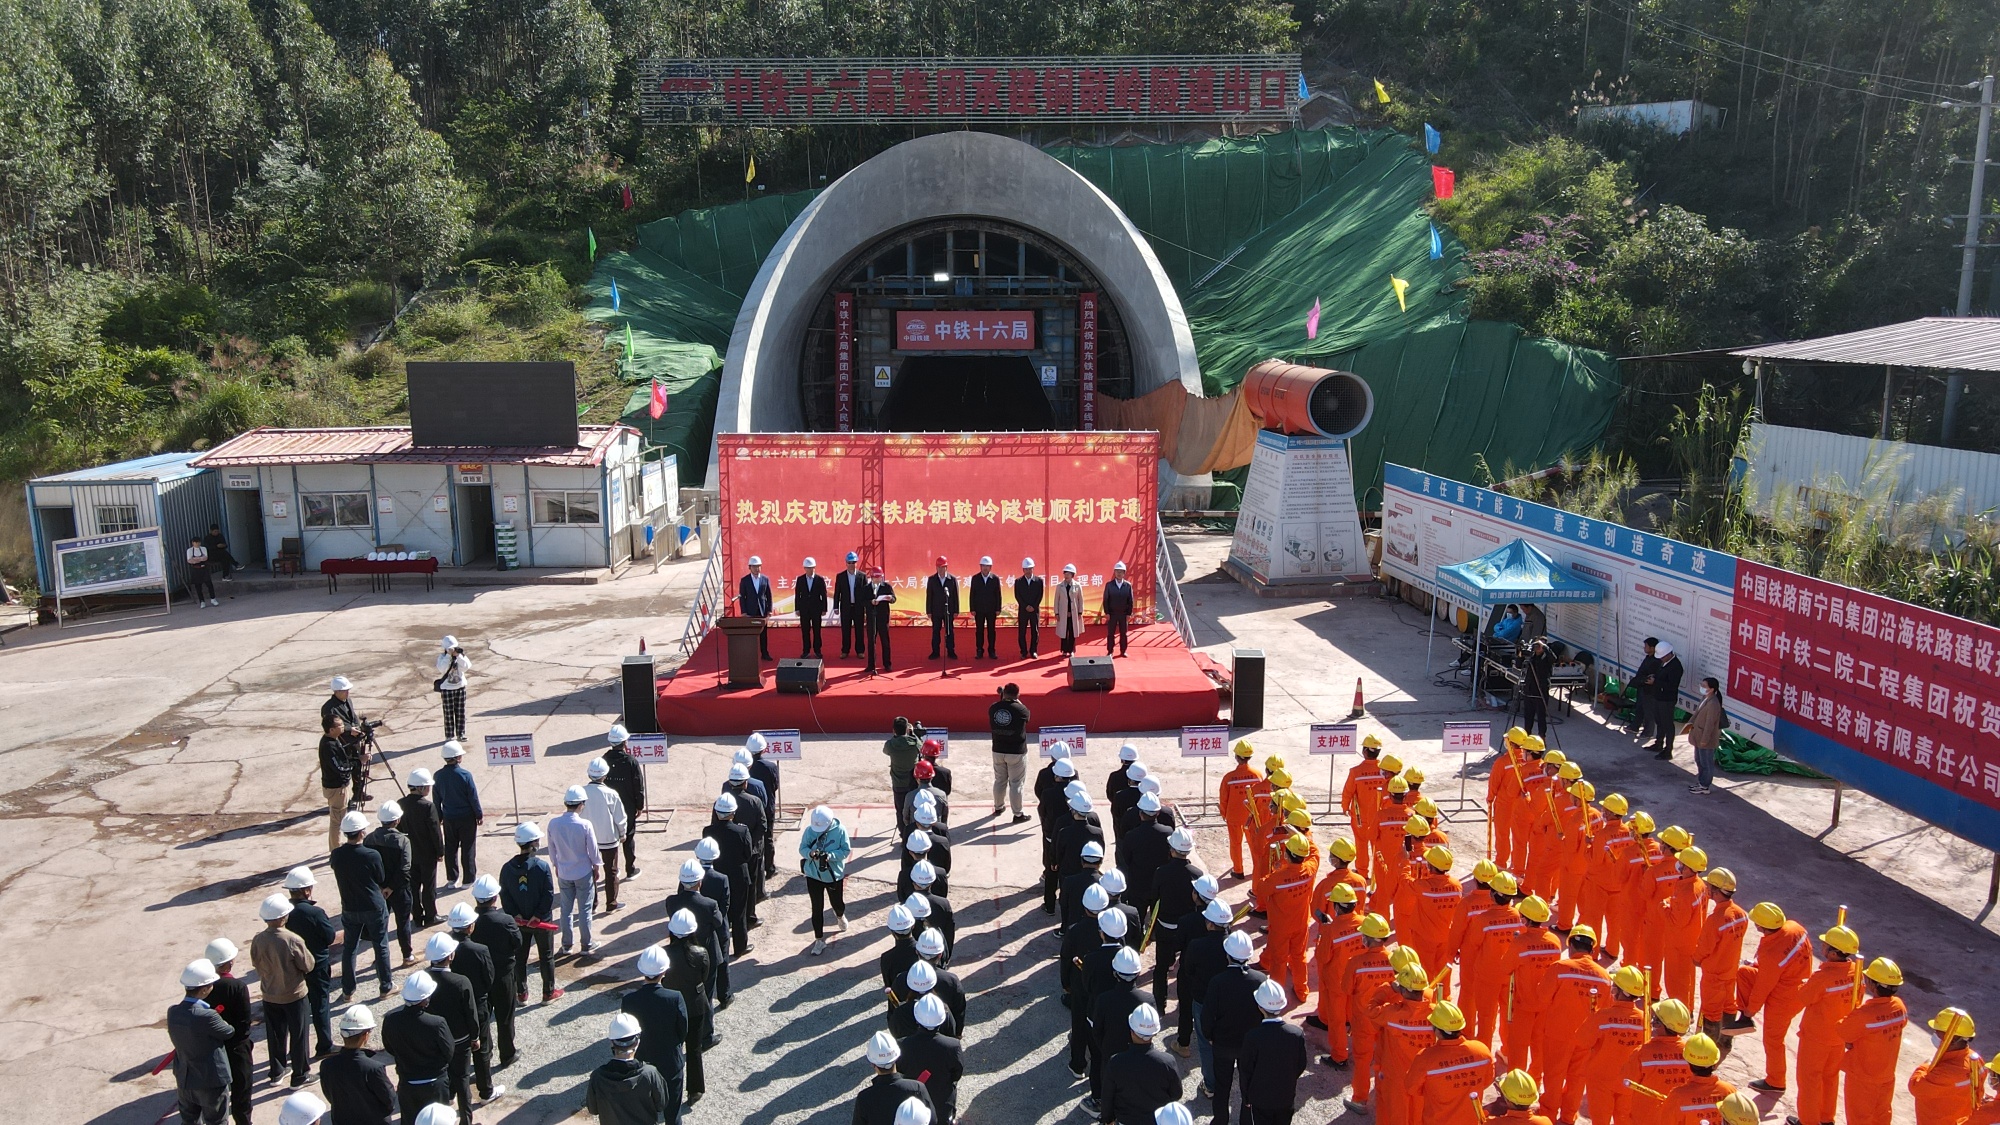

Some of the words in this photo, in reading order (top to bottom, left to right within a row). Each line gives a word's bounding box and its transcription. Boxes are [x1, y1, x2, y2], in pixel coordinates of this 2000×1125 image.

[724, 66, 1287, 116] 中铁十六局集团承建铜鼓岭隧道出口
[934, 320, 1028, 341] 中铁十六局
[839, 299, 849, 432] 中铁十六局集团向广西人民致
[1083, 299, 1094, 431] 热烈庆祝防东铁路隧道全线贯
[736, 497, 1143, 526] 热烈庆祝防东铁路铜鼓岭隧道顺利贯通
[1423, 476, 1524, 521] 责任重于能力
[1553, 512, 1706, 575] 意志创造奇迹
[1738, 619, 2000, 742] 中国中铁二院工程集团祝贺
[1188, 737, 1222, 751] 开挖班
[1317, 735, 1350, 748] 支护班
[1450, 733, 1483, 746] 二衬班
[1734, 665, 2000, 798] 广西宁铁监理咨询有限责任公司
[489, 745, 531, 759] 宁铁监理
